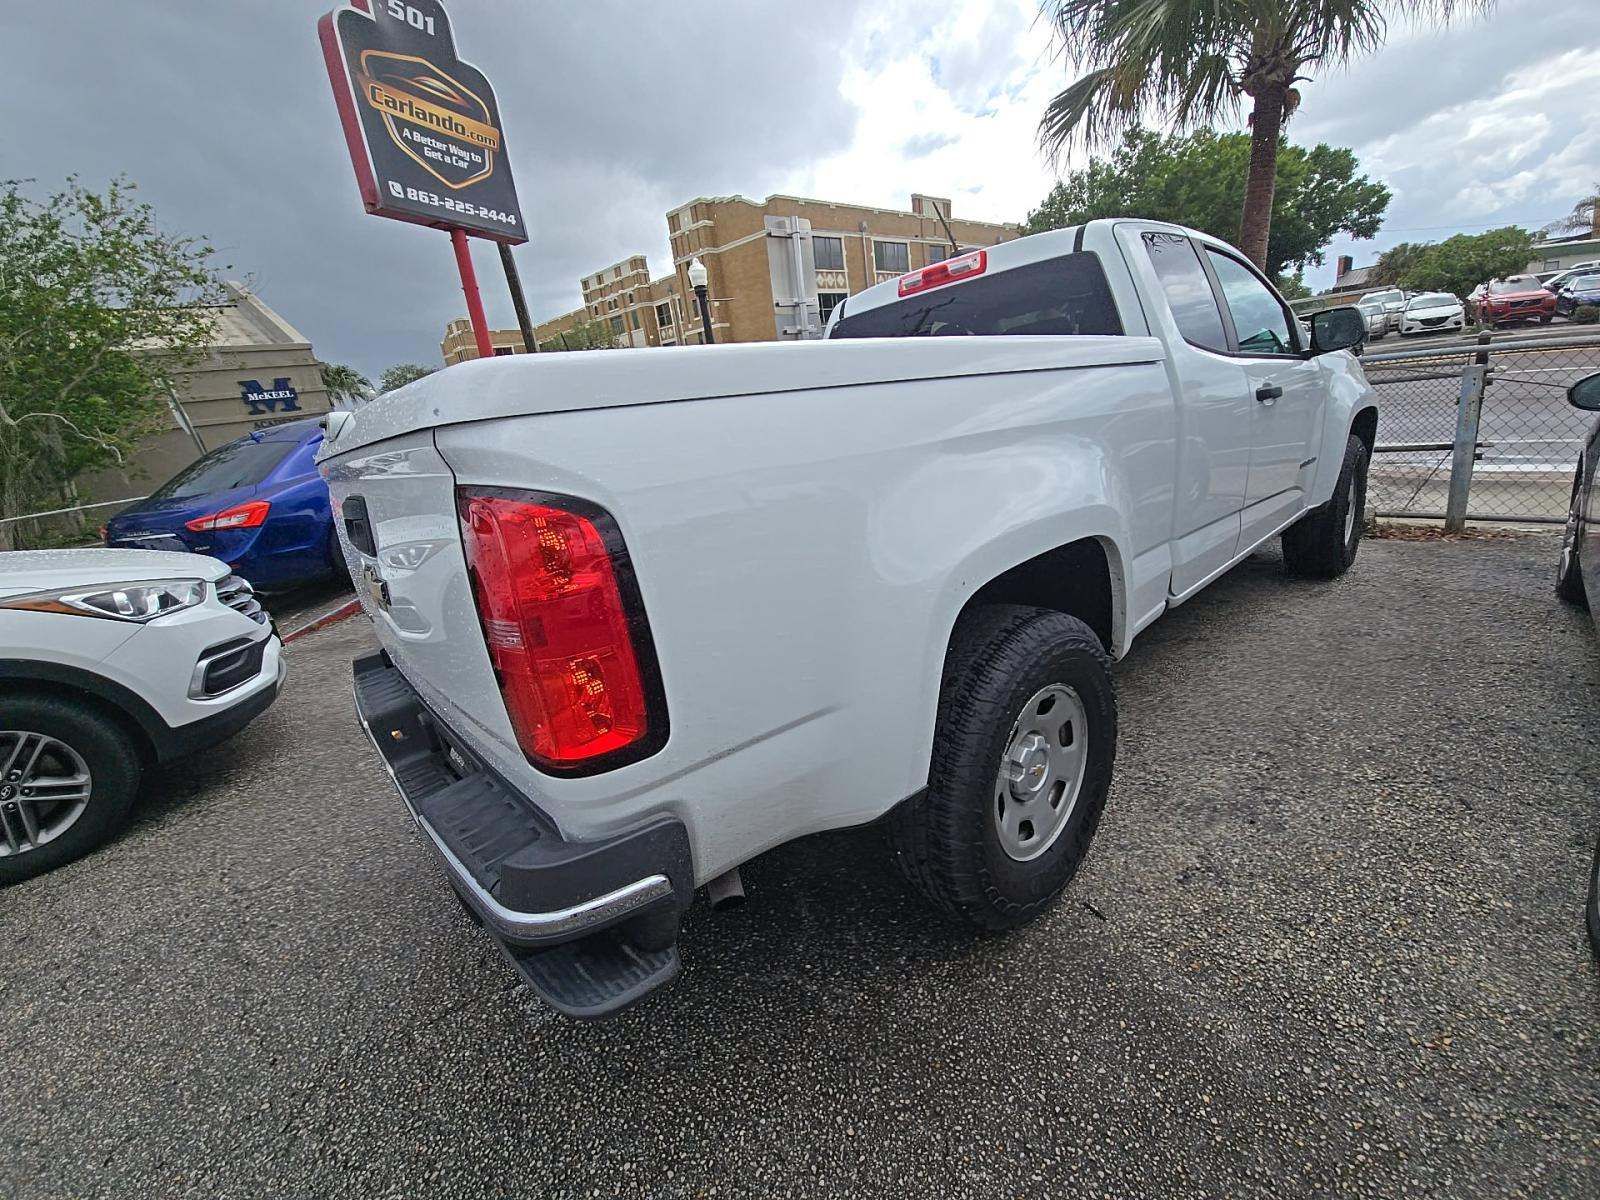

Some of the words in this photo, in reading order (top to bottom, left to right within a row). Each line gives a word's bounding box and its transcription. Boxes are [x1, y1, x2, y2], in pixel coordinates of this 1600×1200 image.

[387, 0, 435, 35] 501
[370, 85, 497, 147] Carlando.com
[402, 128, 412, 139] A
[413, 131, 448, 151] Better
[448, 143, 470, 161] Way
[471, 152, 482, 163] to
[424, 147, 443, 161] Get
[444, 155, 452, 163] a
[452, 156, 469, 168] Car
[407, 187, 516, 225] 863-225-2444
[247, 390, 294, 400] McKEEL
